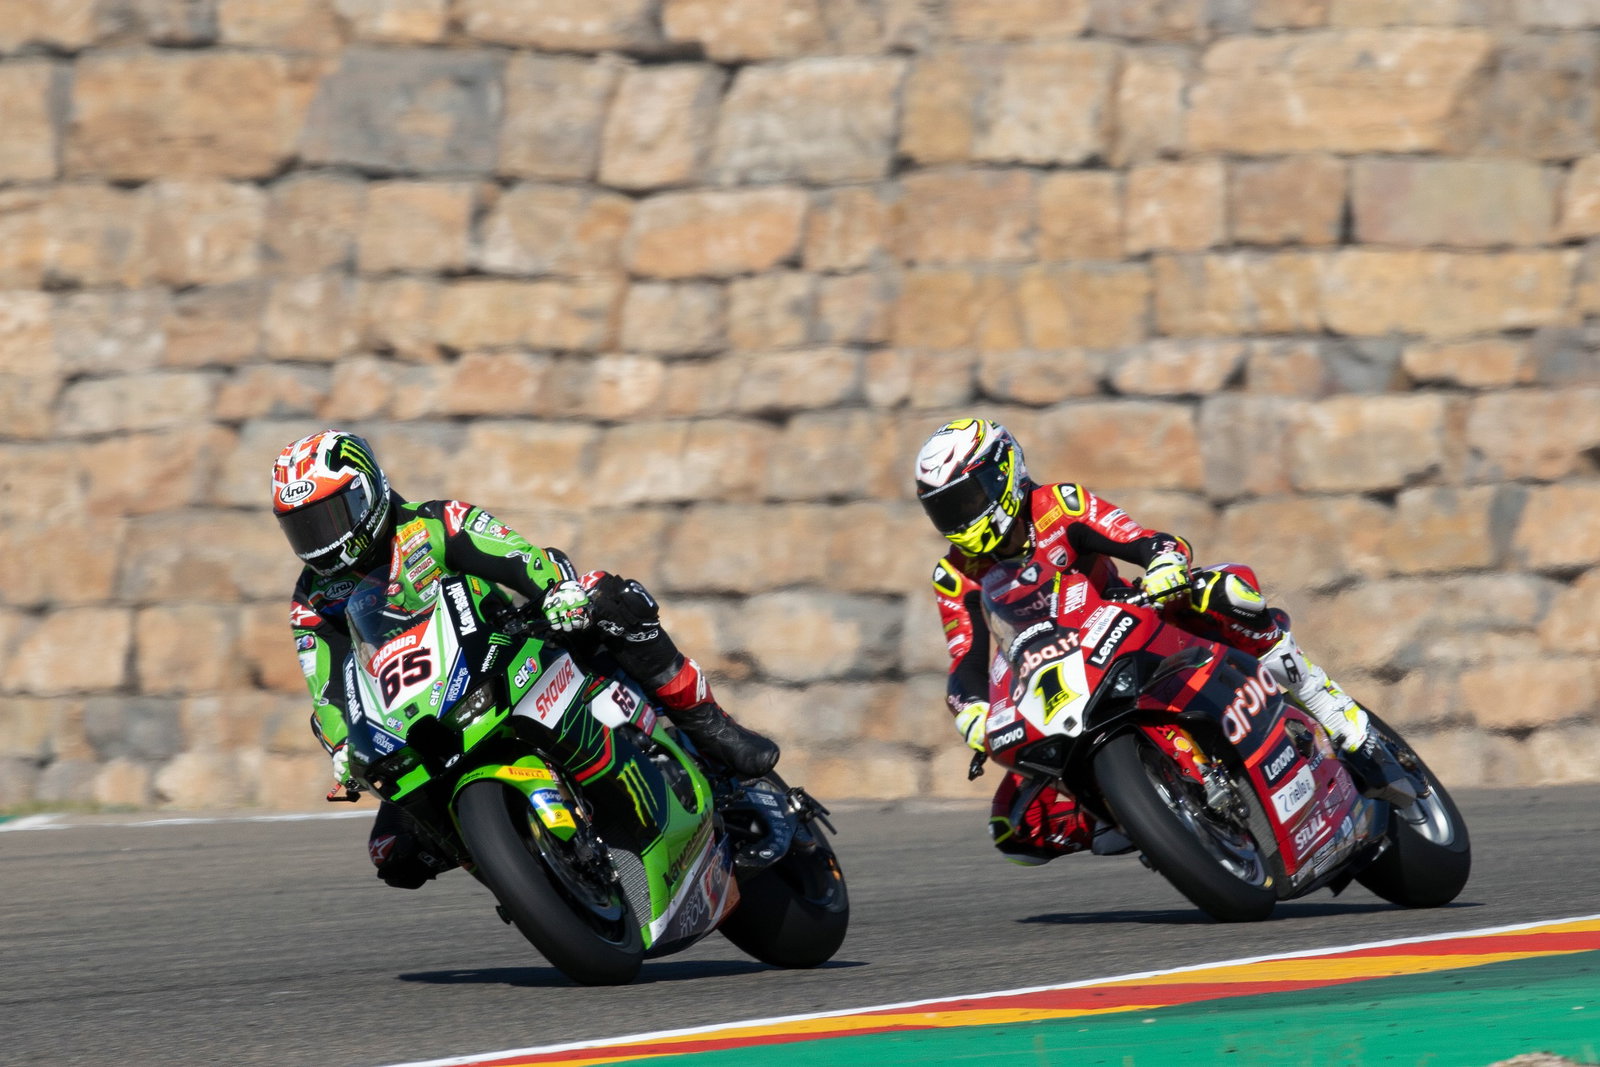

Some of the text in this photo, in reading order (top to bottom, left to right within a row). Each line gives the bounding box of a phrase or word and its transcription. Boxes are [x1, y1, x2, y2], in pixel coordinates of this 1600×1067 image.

[282, 481, 309, 500] Arai
[409, 557, 433, 580] SHOWA
[446, 582, 477, 636] Kawasaki
[372, 634, 417, 673] SHOWA
[481, 645, 498, 672] MONSTER
[1091, 616, 1133, 665] Lenovo
[345, 658, 362, 725] Kawasaki
[379, 648, 432, 709] 65
[514, 665, 531, 688] elf
[535, 659, 575, 720] SHOWA
[1033, 662, 1081, 725] 1
[990, 727, 1024, 751] Lenovo
[508, 767, 545, 778] PIRELLI
[1264, 744, 1295, 781] Lenovo
